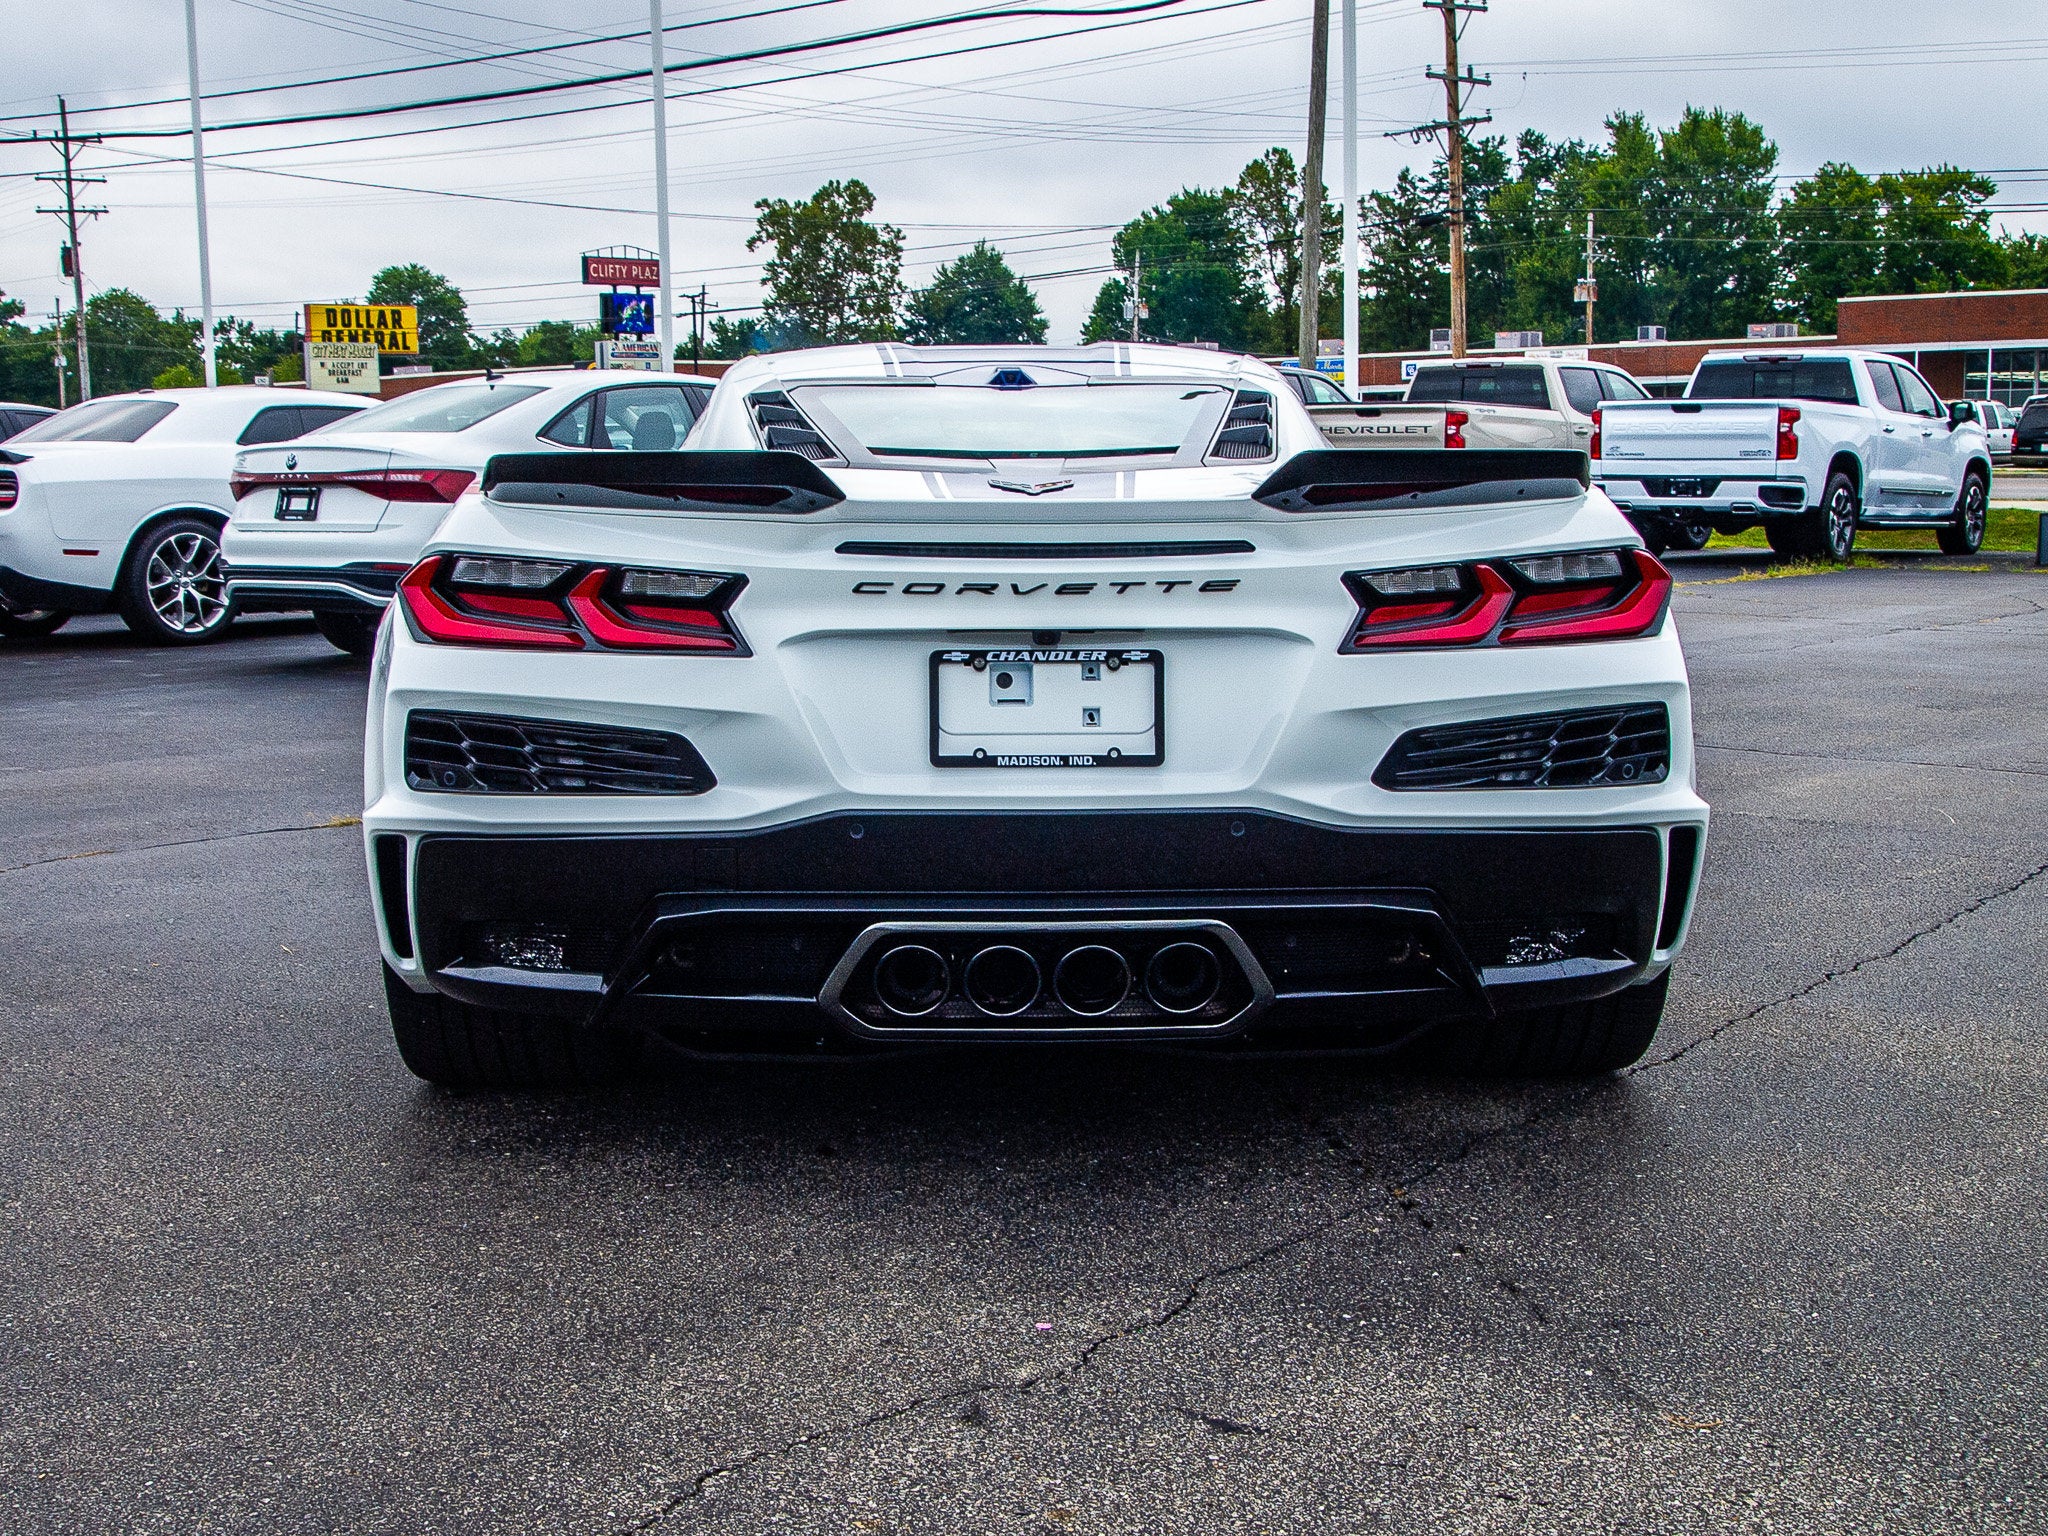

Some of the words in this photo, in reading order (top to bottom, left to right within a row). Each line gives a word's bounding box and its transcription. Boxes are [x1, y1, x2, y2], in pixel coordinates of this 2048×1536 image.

[590, 263, 627, 278] CLIFTY
[632, 266, 659, 280] PLAZ
[326, 308, 403, 329] DOLLAR
[321, 330, 411, 351] GENERAL
[622, 343, 659, 352] AMERICAN
[1320, 425, 1433, 434] HEVROLET
[852, 578, 1242, 596] CORVETTE
[986, 651, 1107, 662] CHANDLER
[1069, 756, 1097, 766] IND.
